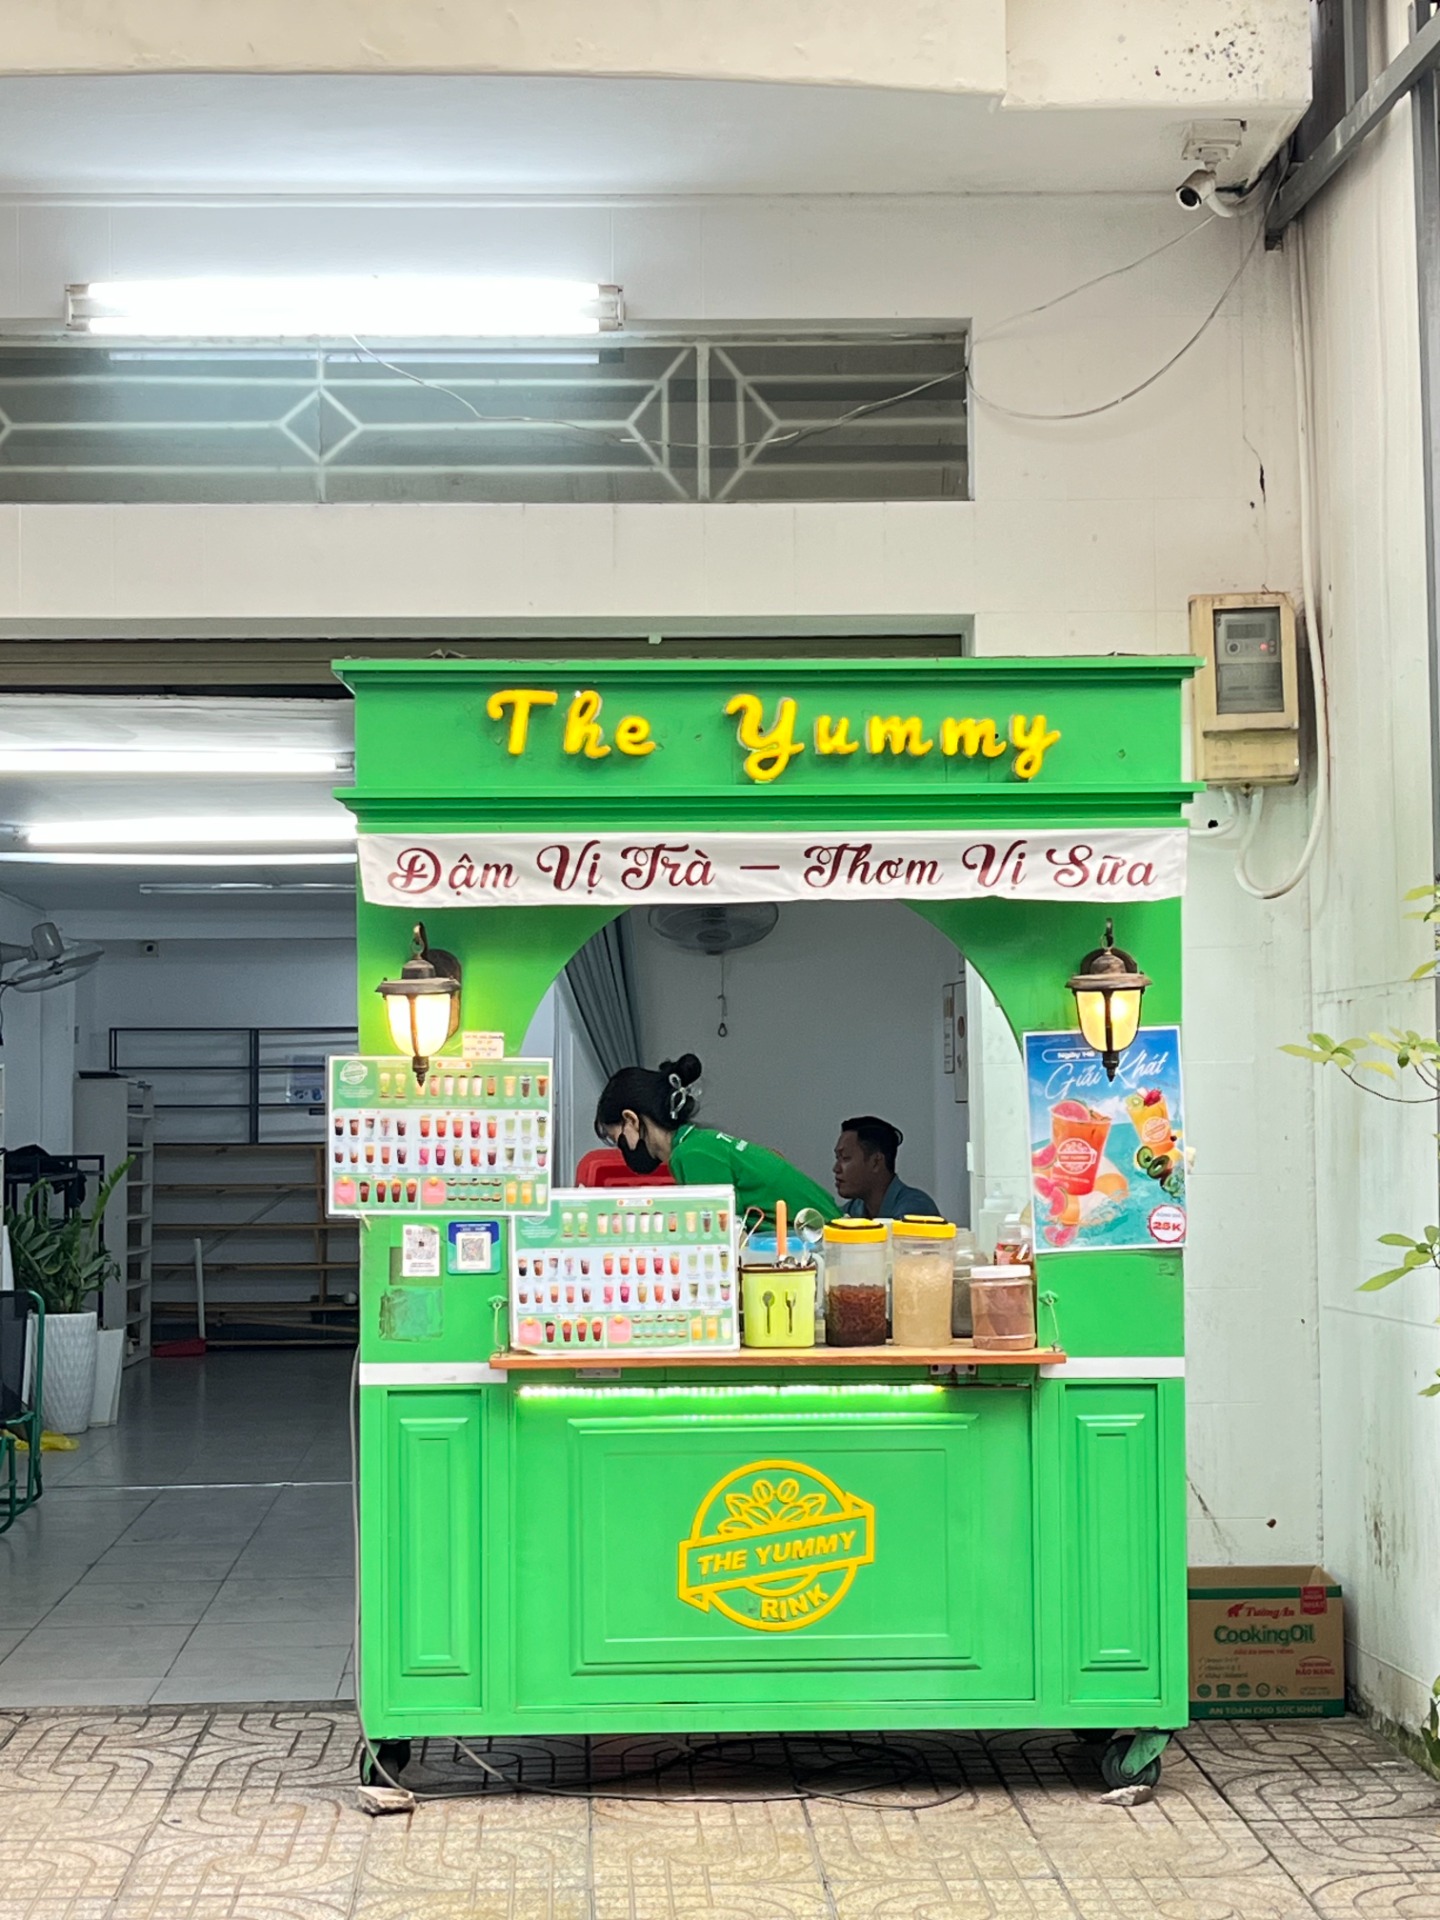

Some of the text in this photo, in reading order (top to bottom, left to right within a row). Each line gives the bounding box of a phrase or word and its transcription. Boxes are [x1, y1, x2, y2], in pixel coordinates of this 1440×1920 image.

[486, 689, 1061, 784] The Yummy
[387, 847, 520, 896] Đậm
[536, 839, 603, 894] Vị
[620, 843, 716, 891] Trà
[803, 843, 944, 888] Thơm
[962, 839, 1029, 891] Vị
[1046, 844, 1158, 888] Sữa
[1115, 1049, 1169, 1089] Khát
[697, 1530, 856, 1576] THE YUMMY
[760, 1583, 830, 1621] RINK
